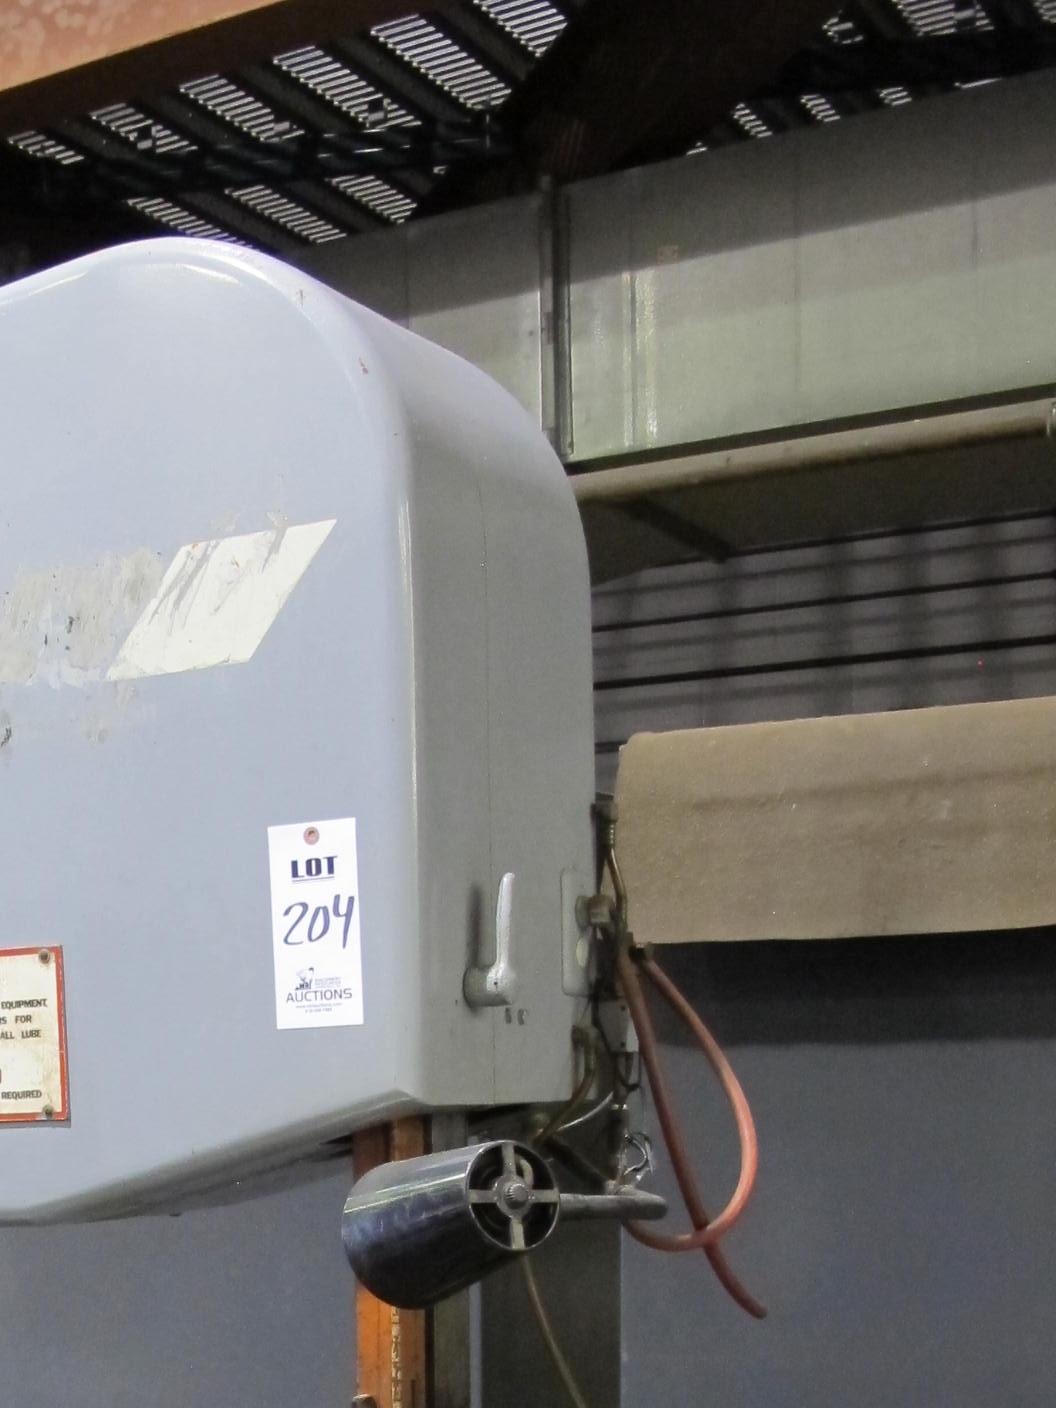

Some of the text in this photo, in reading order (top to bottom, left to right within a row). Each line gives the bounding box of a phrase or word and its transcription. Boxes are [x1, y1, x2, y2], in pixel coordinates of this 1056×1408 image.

[290, 855, 338, 879] LOT
[282, 894, 355, 950] 204
[286, 988, 353, 1003] AUCTIONS
[15, 1014, 32, 1024] FOR
[0, 1031, 15, 1040] ALL
[21, 1029, 42, 1039] LUBE
[1, 1090, 42, 1100] REQUIRED
